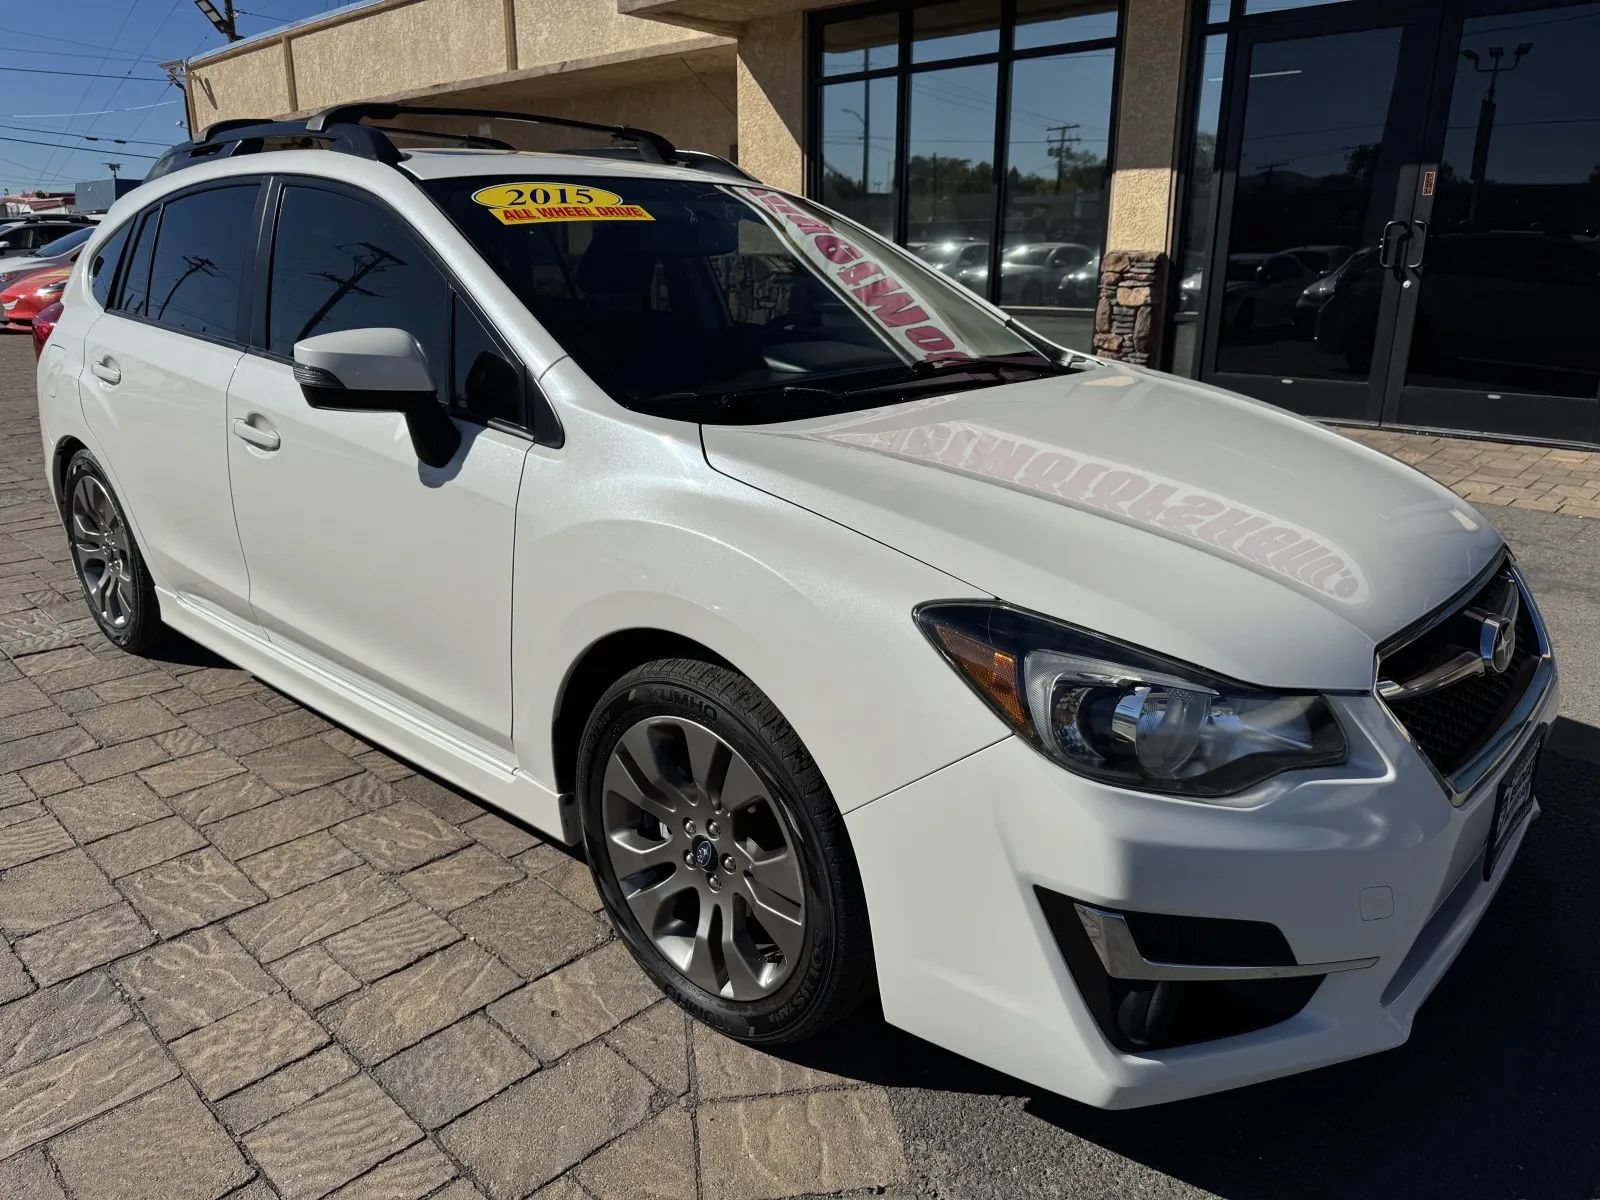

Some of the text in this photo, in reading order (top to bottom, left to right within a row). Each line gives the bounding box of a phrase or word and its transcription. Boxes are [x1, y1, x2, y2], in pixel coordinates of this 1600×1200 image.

[505, 188, 594, 206] 2015
[503, 206, 644, 221] ALL WHEEL DRIVE
[648, 687, 718, 722] KUMHO
